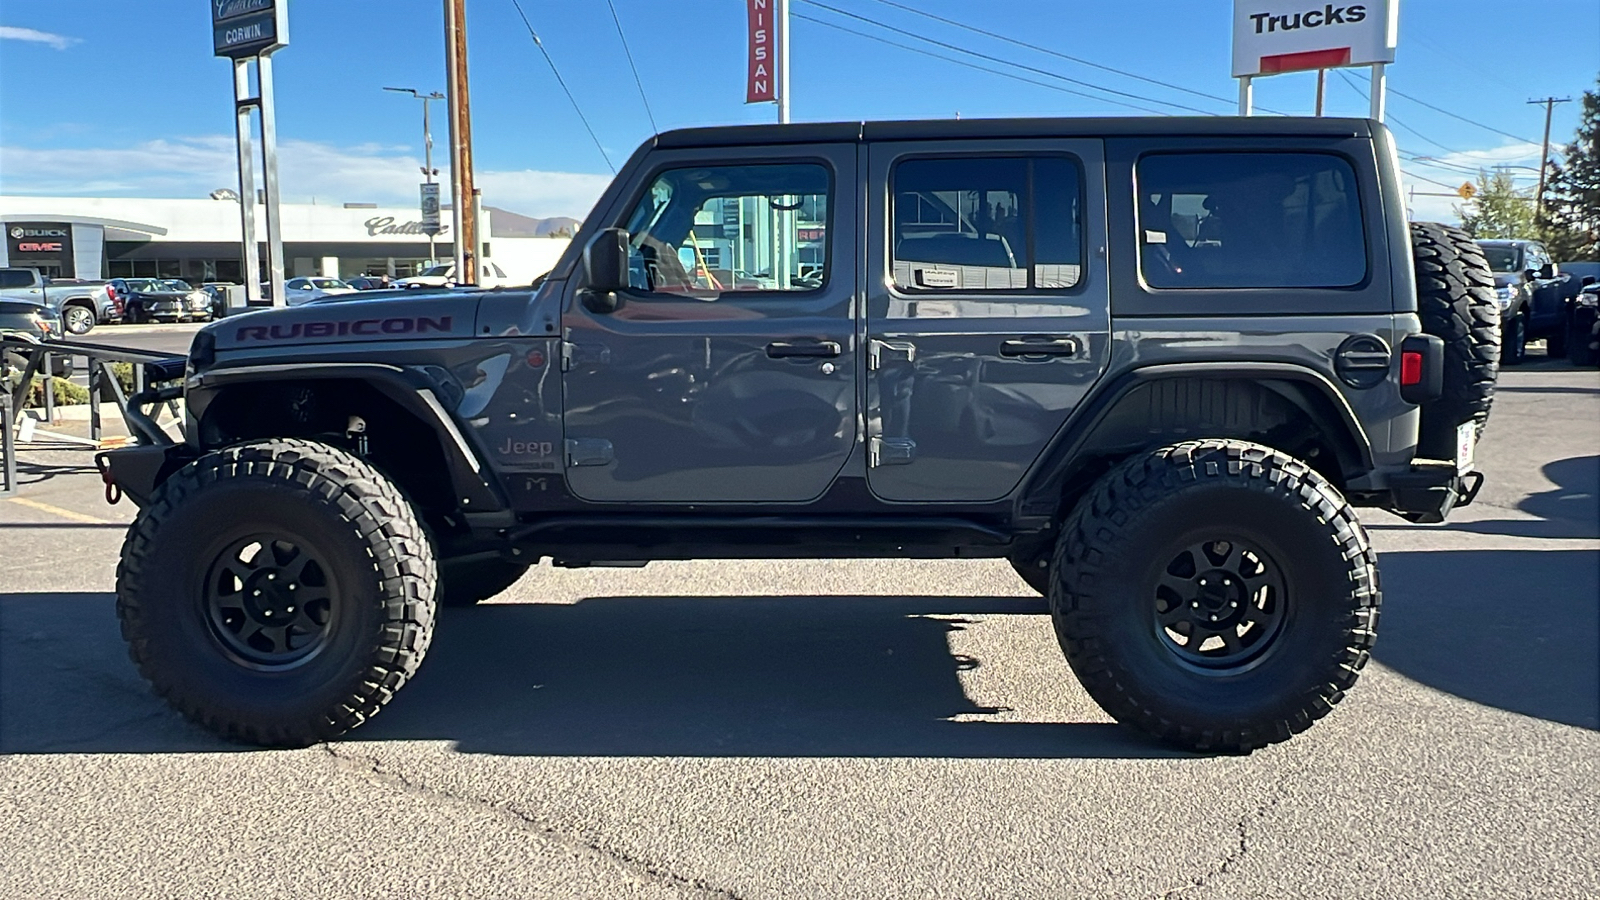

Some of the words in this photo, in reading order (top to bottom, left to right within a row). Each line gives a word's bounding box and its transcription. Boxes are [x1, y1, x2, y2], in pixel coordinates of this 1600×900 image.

[1250, 4, 1366, 34] Trucks
[226, 23, 261, 43] CORWIN
[755, 0, 767, 93] NISSAN
[25, 229, 67, 237] BUICK
[19, 242, 62, 251] GMC
[236, 316, 452, 341] RUBICON
[498, 437, 553, 457] Jeep
